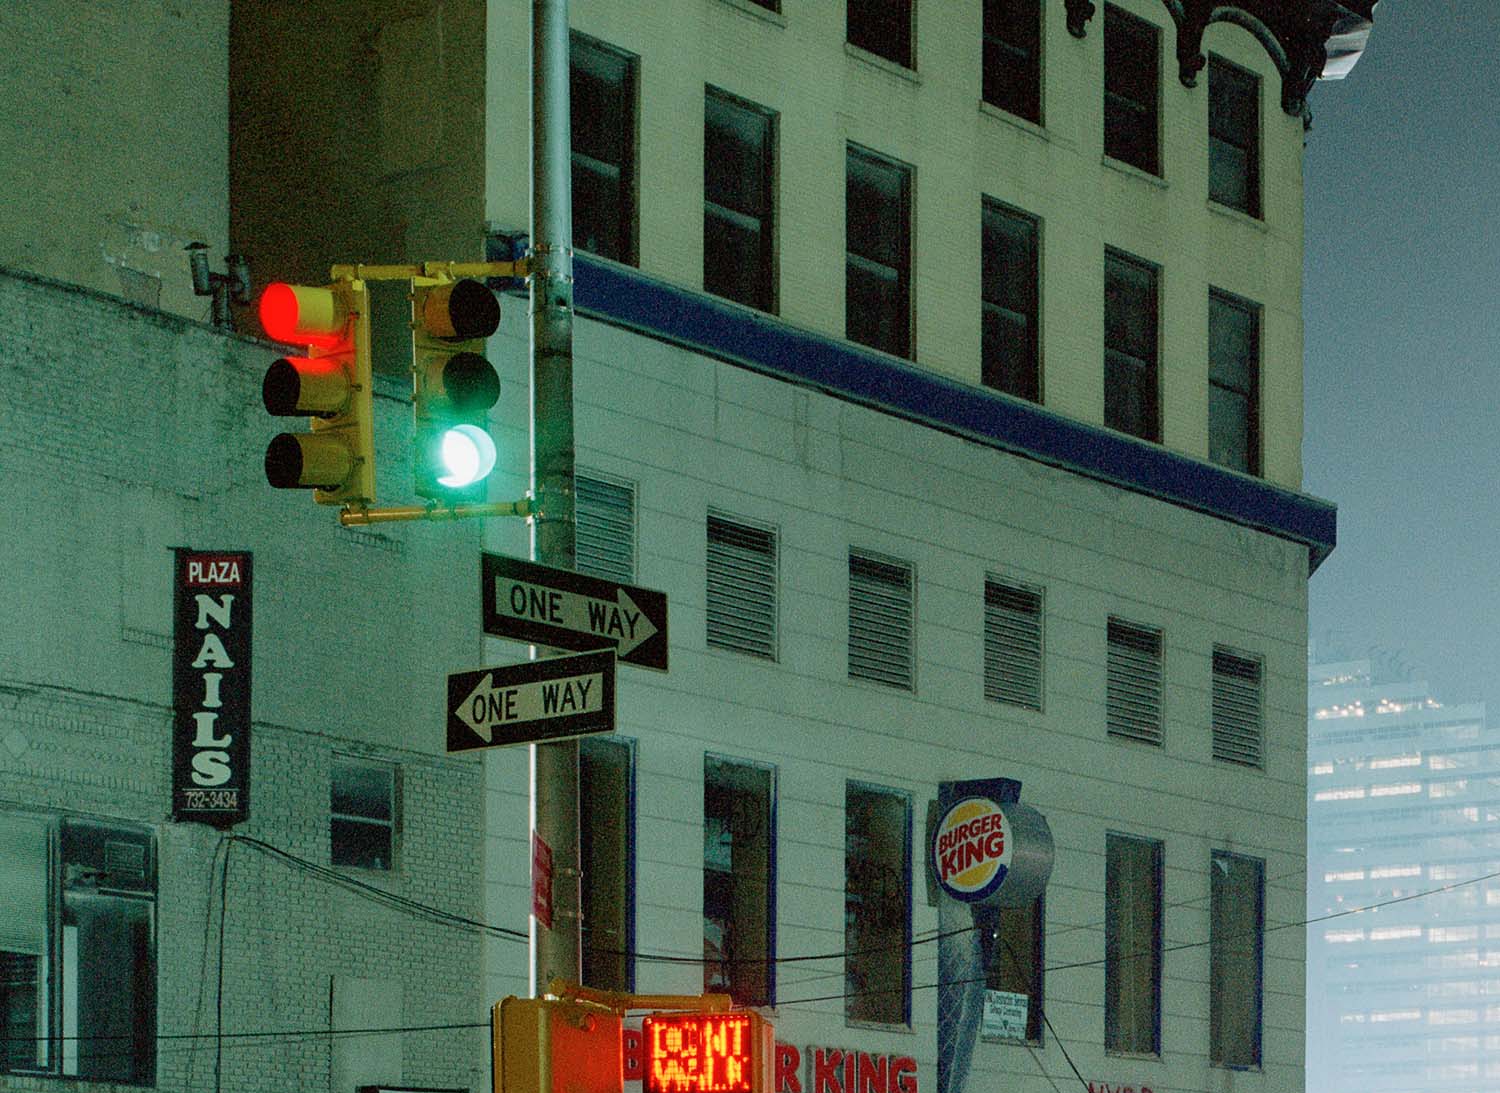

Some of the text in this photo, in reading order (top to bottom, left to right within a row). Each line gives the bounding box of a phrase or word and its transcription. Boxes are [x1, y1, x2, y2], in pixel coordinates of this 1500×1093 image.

[189, 561, 240, 583] PLAZA
[510, 584, 640, 639] ONE WAY
[191, 594, 235, 786] NAILS
[472, 678, 593, 724] ONE WAY
[186, 791, 238, 808] 732-3434
[938, 813, 1003, 856] BURGER
[941, 831, 1005, 881] KING
